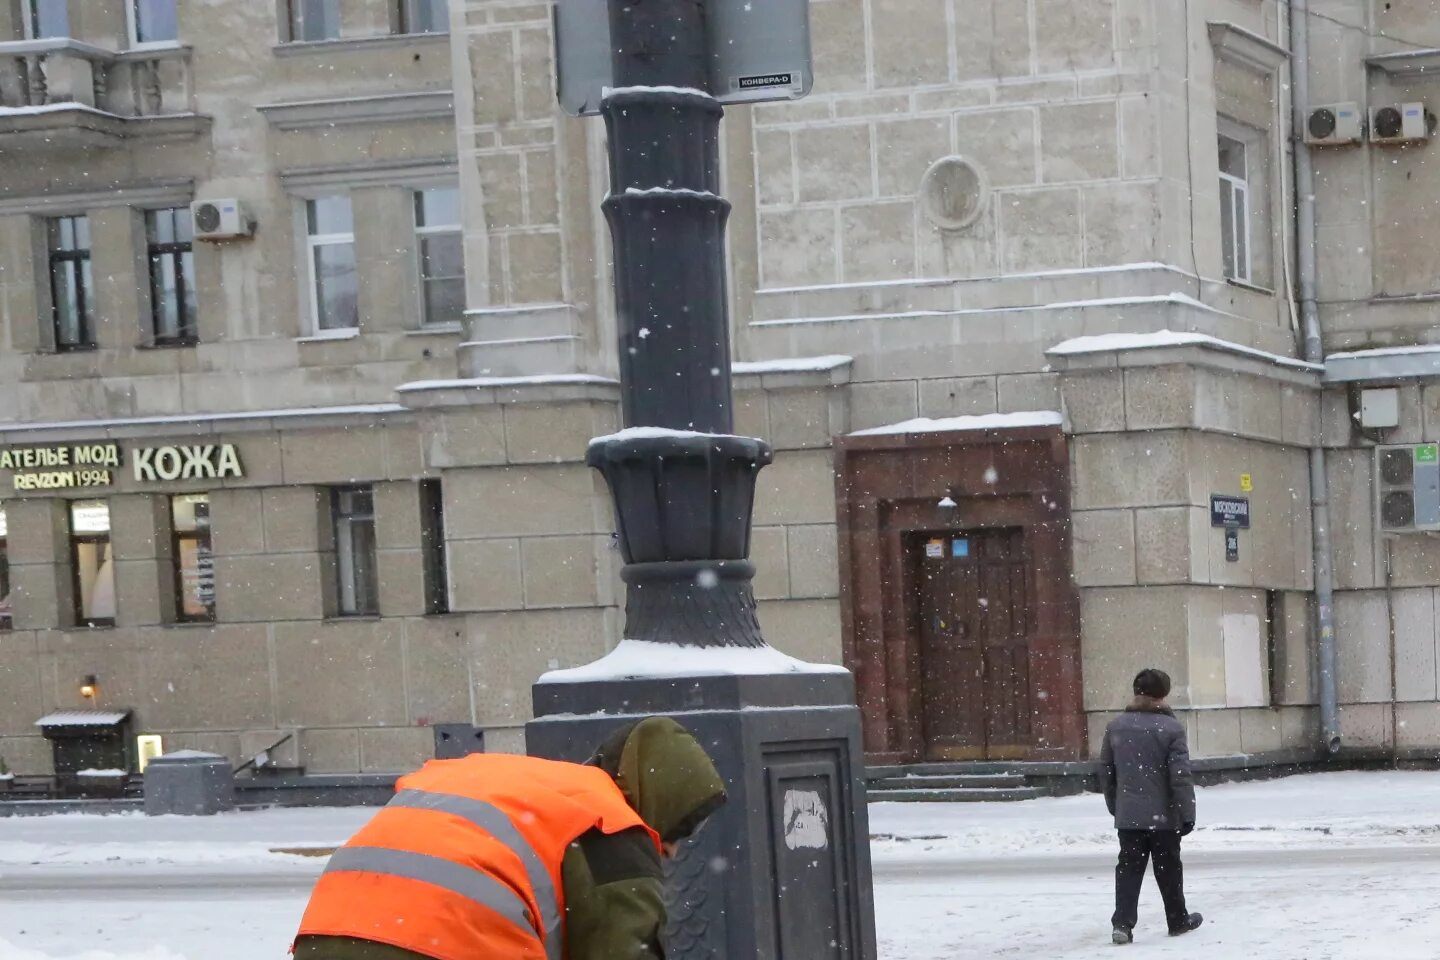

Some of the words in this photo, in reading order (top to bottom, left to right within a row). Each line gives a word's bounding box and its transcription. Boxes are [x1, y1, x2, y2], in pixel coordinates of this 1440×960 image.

[1, 448, 69, 468] АТЕЛЬЕ
[74, 444, 119, 466] МОД
[133, 444, 243, 481] КОЖА
[14, 472, 74, 489] REVZON
[76, 470, 110, 486] 1994
